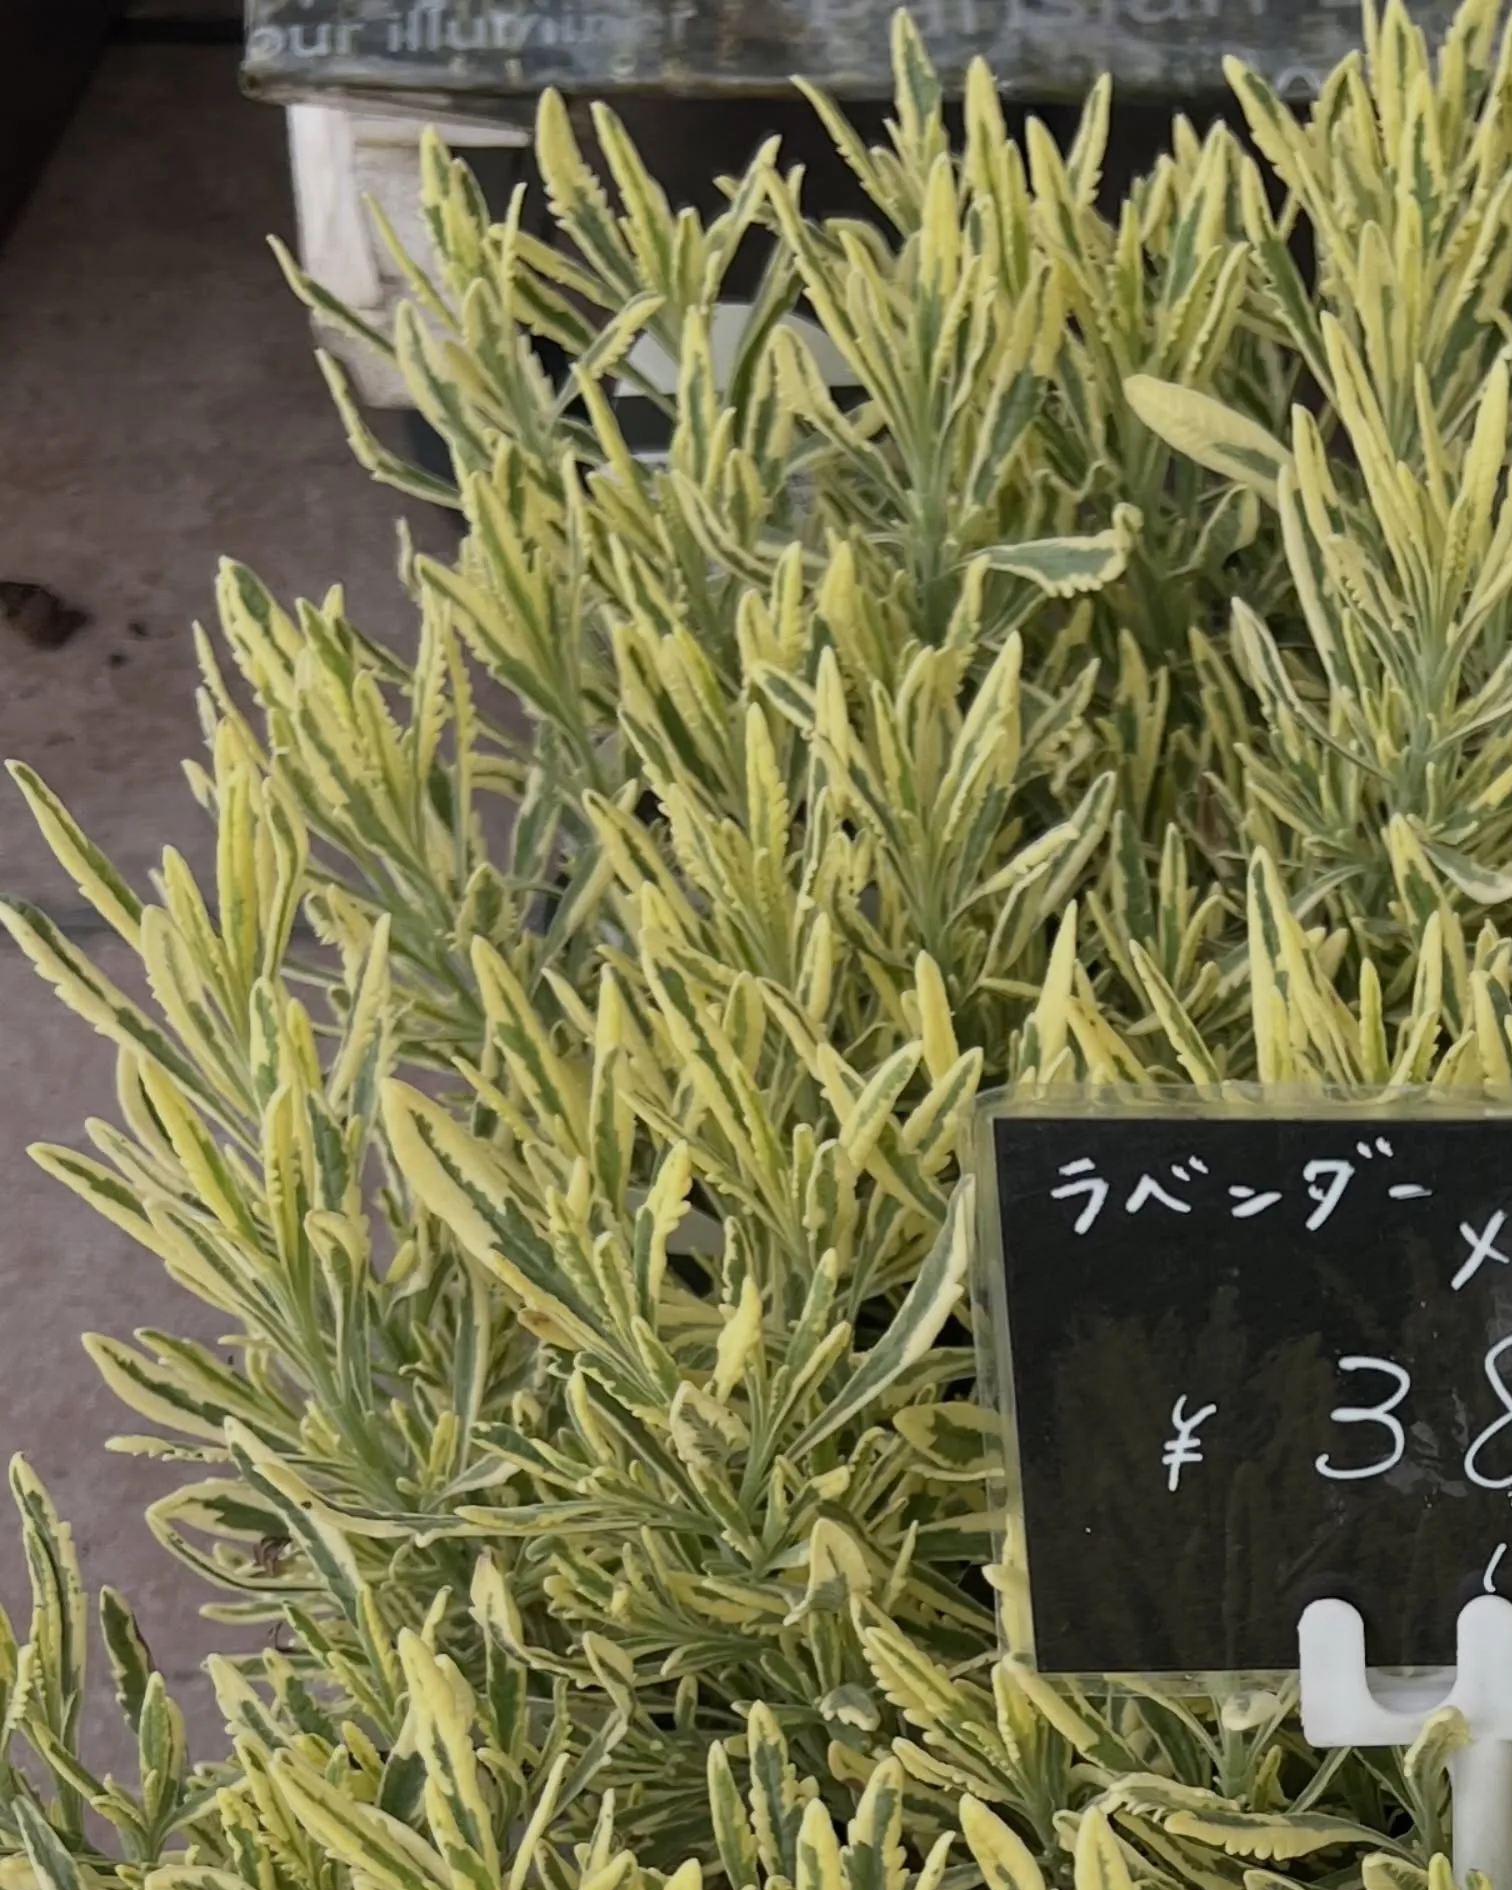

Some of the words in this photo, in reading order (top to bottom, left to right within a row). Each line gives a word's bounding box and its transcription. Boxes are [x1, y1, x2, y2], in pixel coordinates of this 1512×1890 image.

[1051, 1137, 1432, 1234] ラベンダー
